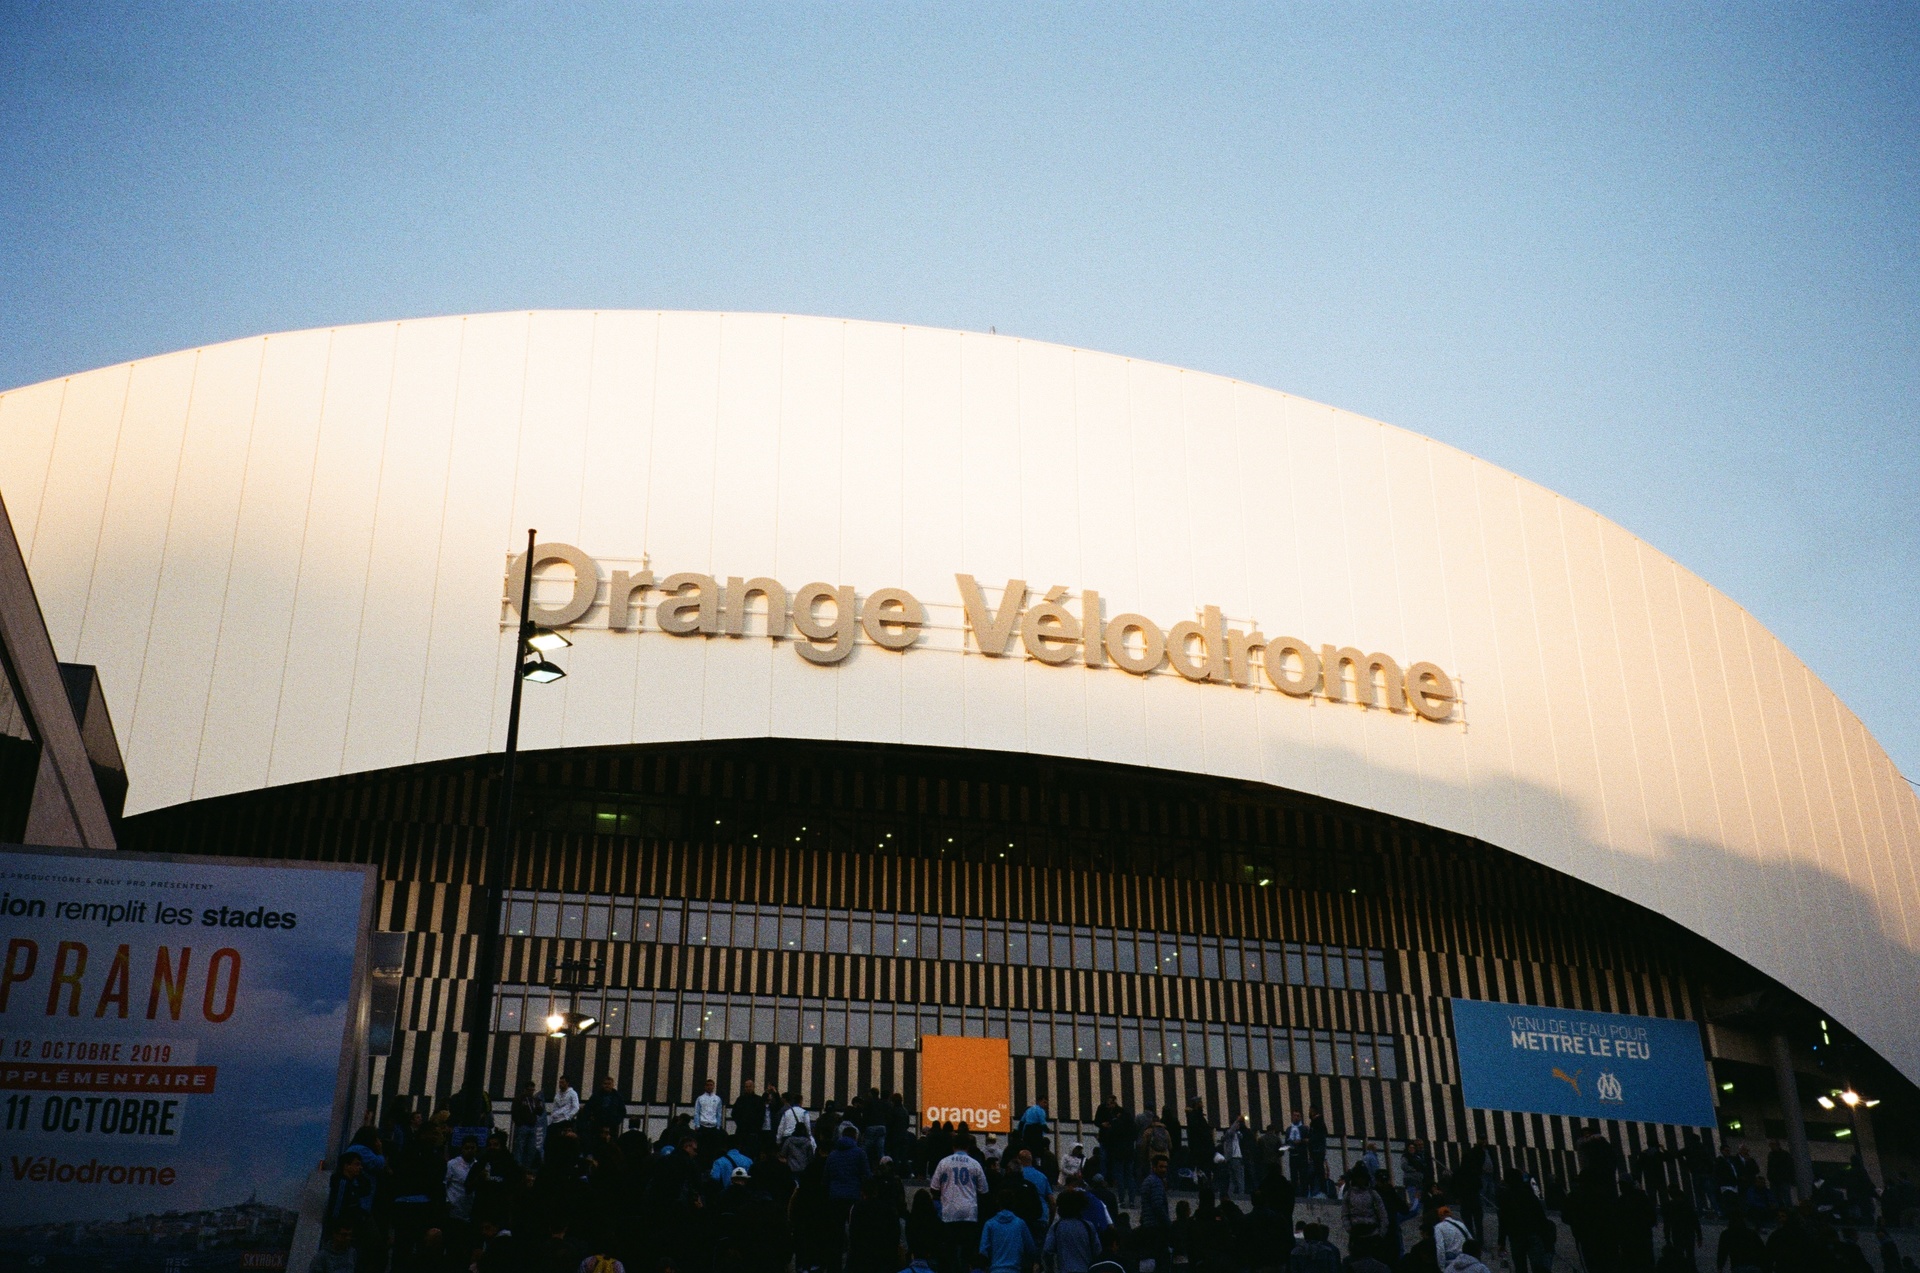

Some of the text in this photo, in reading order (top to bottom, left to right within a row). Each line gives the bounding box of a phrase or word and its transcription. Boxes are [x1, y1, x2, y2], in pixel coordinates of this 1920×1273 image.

[508, 542, 1456, 720] Orange Vélodrome
[9, 873, 81, 883] PRODUCTIONS
[97, 878, 121, 886] ONLY
[0, 892, 297, 930] ion remplit les stades
[0, 938, 241, 1023] PRANO
[1507, 1015, 1648, 1041] VENU DE L'EAU POUR
[14, 1040, 31, 1058] 12
[41, 1041, 121, 1061] OCTOBRE
[130, 1045, 172, 1063] 2019
[1511, 1031, 1650, 1060] METTRE LE FEU
[0, 1069, 207, 1087] PPLÉMENTAIRE
[6, 1094, 178, 1135] 11 OCTOBRE
[926, 1106, 1001, 1128] orange
[11, 1155, 176, 1186] Vélodrome
[952, 1167, 970, 1185] 10
